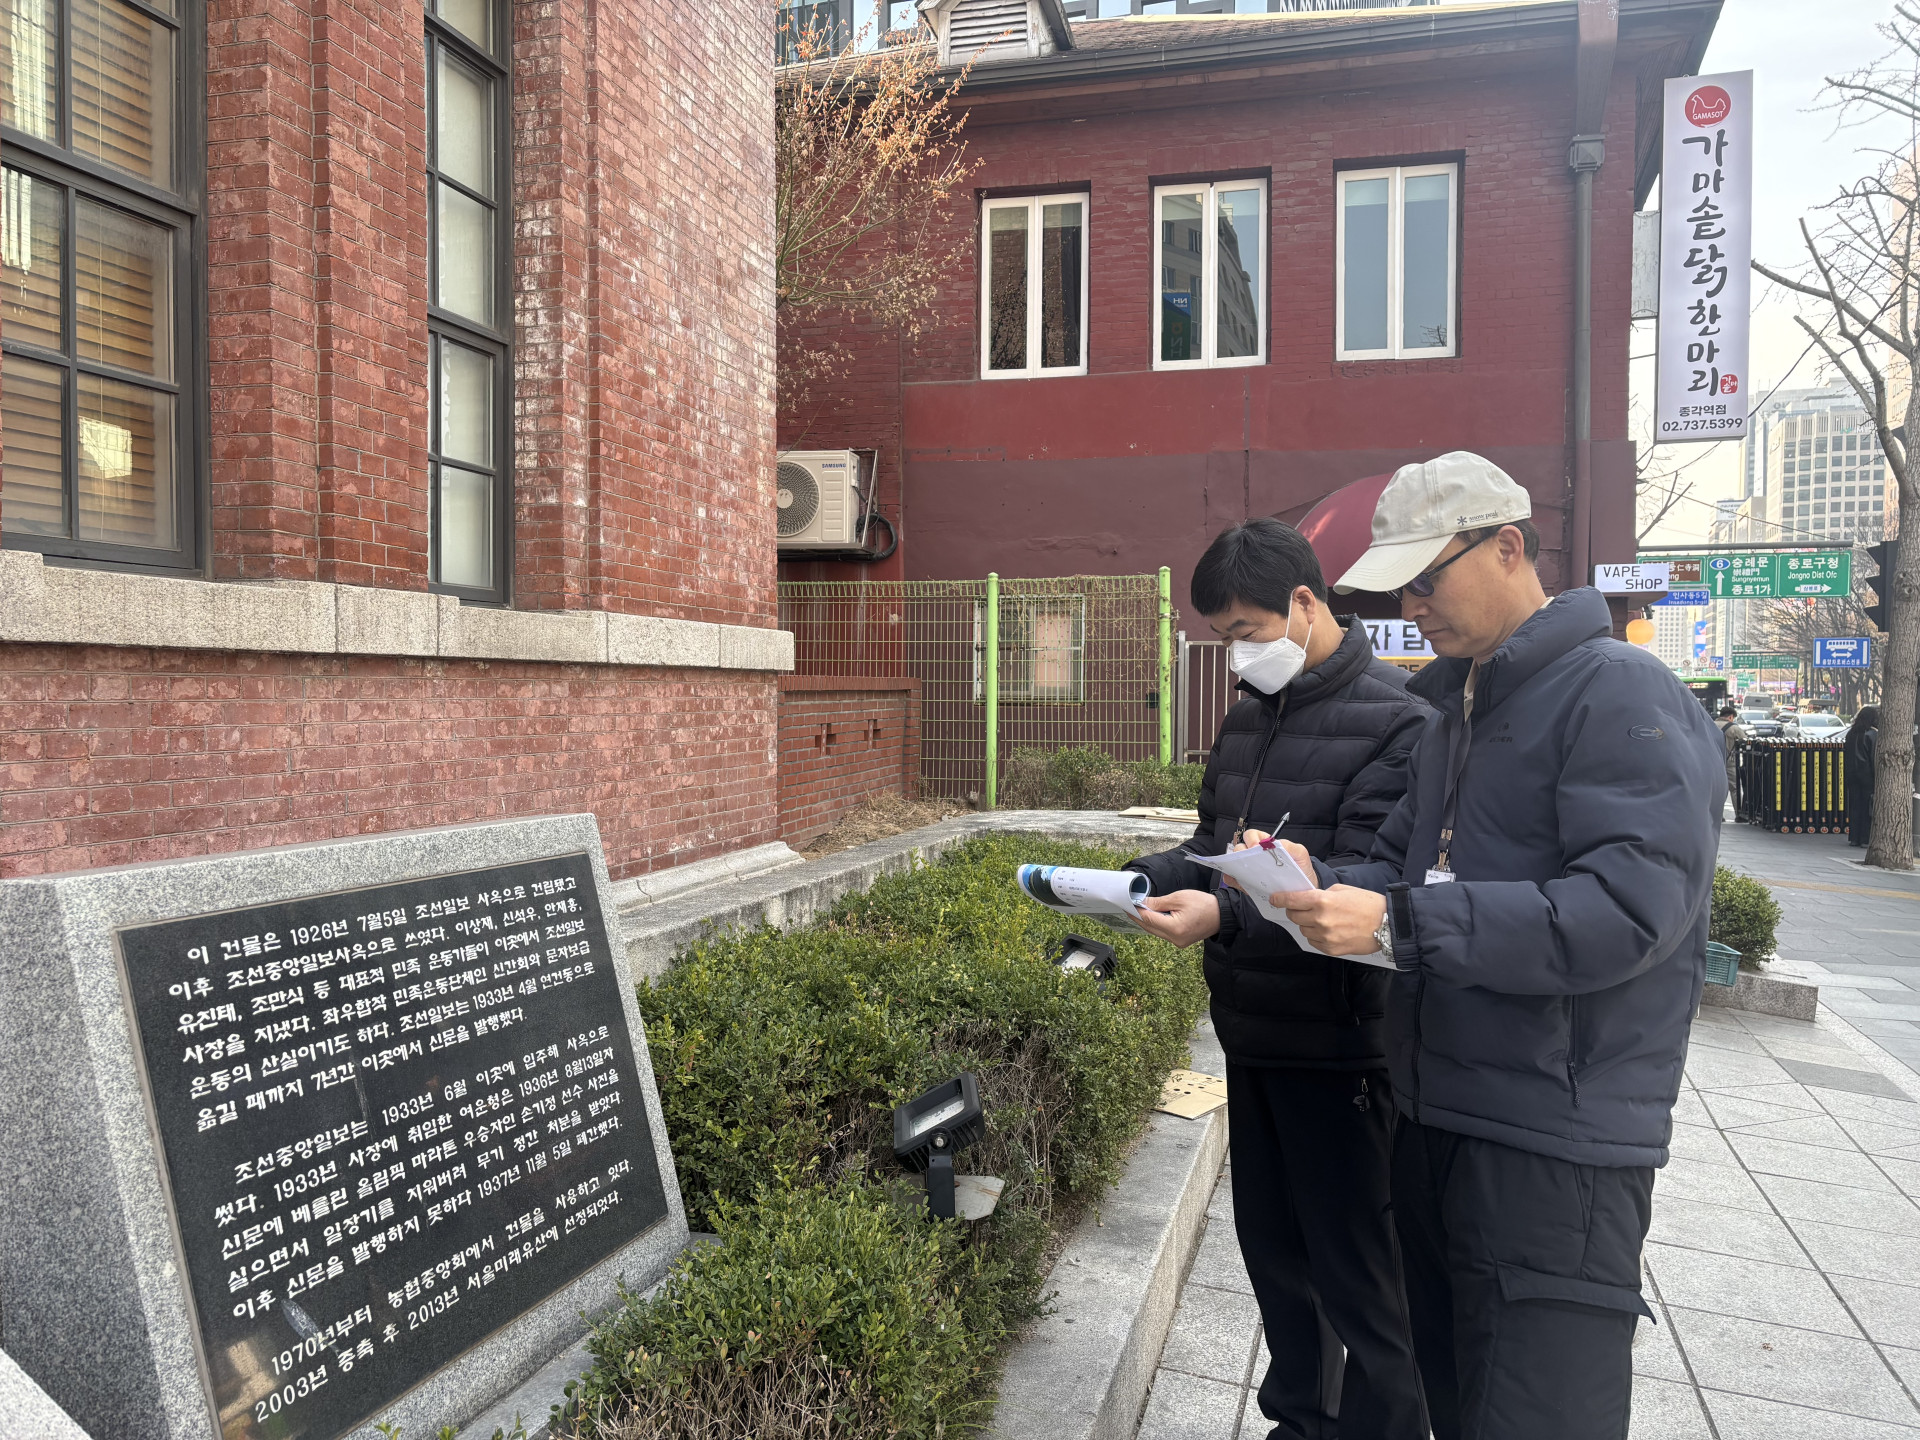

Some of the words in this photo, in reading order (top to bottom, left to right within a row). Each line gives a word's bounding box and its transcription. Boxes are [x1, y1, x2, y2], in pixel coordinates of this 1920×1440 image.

[1692, 110, 1724, 120] GAMASOT
[1662, 418, 1743, 432] 02.737.5399
[1679, 404, 1727, 417] 종각역점
[1603, 566, 1641, 578] VAPE
[1625, 578, 1663, 590] SHOP
[1672, 592, 1708, 600] 인사동5길
[1716, 560, 1724, 568] 6
[1731, 557, 1769, 568] 숭례문
[1731, 576, 1770, 584] Sungnyemun
[1731, 584, 1772, 595] 종로1가
[1787, 557, 1839, 569] 종로구청
[1787, 571, 1811, 581] Jongno
[1811, 571, 1825, 579] Dist
[1826, 570, 1838, 579] Ofc
[168, 977, 214, 1000] 이후
[405, 926, 450, 948] 쓰였다.
[455, 916, 498, 935] 이상재,
[502, 907, 541, 927] 신석우,
[544, 898, 582, 917] 안재홍,
[187, 946, 209, 964] 이
[220, 932, 281, 960] 건물은
[290, 919, 349, 945] 1926년
[357, 908, 407, 932] 7월5일
[415, 896, 470, 920] 조선일보
[477, 886, 526, 907] 사옥으로
[177, 1003, 243, 1035] 유진태,
[251, 986, 305, 1015] 조만식
[313, 980, 331, 1000] 등
[338, 967, 385, 991] 대표적
[392, 958, 421, 979] 민족
[428, 941, 490, 970] 운동가들이
[494, 929, 540, 952] 이곳에서
[545, 919, 586, 940] 조선일보
[183, 1033, 245, 1064] 사장을
[254, 1015, 316, 1043] 지냈다.
[322, 994, 387, 1025] 좌우합작
[392, 967, 488, 1007] 민족운동단체인
[492, 953, 541, 979] 신간회와
[546, 940, 590, 964] 문자보급
[189, 1063, 252, 1099] 운동의
[261, 1034, 351, 1077] 산실이기도
[357, 1022, 394, 1043] 하다.
[399, 1000, 470, 1033] 조선일보는
[472, 985, 515, 1011] 1933년
[518, 978, 538, 995] 4월
[540, 961, 595, 990] 연건동으로
[196, 1100, 238, 1132] 옮길
[245, 1078, 304, 1110] 때까지
[310, 1062, 356, 1090] 7년간
[361, 1039, 423, 1071] 이곳에서
[429, 1024, 470, 1052] 신문을
[474, 1006, 527, 1037] 발행했다.
[214, 1193, 264, 1228] 썼다.
[273, 1160, 338, 1201] 1933년
[348, 1135, 398, 1167] 사장에
[407, 1113, 453, 1144] 취임한
[459, 1088, 514, 1120] 여운형은
[519, 1069, 559, 1097] 1936년
[565, 1047, 614, 1078] 8월13일자
[234, 1120, 368, 1184] 조선중앙일보는
[382, 1092, 434, 1126] 1933년
[444, 1079, 468, 1101] 6월
[476, 1061, 515, 1086] 이곳에
[523, 1044, 559, 1070] 입주해
[566, 1025, 610, 1051] 사옥으로
[221, 1215, 284, 1260] 신문에
[291, 1187, 349, 1223] 베를린
[357, 1162, 406, 1199] 올림픽
[411, 1138, 458, 1169] 마라톤
[463, 1113, 515, 1148] 우승자인
[520, 1095, 556, 1124] 손기정
[561, 1084, 584, 1105] 선수
[587, 1068, 619, 1091] 사진을
[228, 1238, 309, 1293] 실으면서
[323, 1198, 395, 1246] 일장기를
[407, 1163, 467, 1203] 지워버려
[477, 1146, 504, 1169] 무기
[513, 1129, 539, 1153] 정간
[547, 1109, 582, 1134] 처분을
[588, 1090, 624, 1117] 받았다.
[233, 1290, 276, 1319] 이후
[286, 1256, 345, 1299] 신문을
[351, 1215, 420, 1265] 발행하지
[427, 1190, 472, 1226] 못하다
[477, 1165, 521, 1199] 1937년
[525, 1151, 547, 1174] 11월
[552, 1140, 572, 1161] 5일
[576, 1116, 623, 1146] 폐간했다.
[271, 1305, 373, 1375] 1970년부터
[388, 1235, 495, 1308] 농협중앙회에서
[505, 1207, 545, 1241] 건물을
[555, 1176, 600, 1210] 사용하고
[608, 1159, 633, 1183] 있다.
[255, 1364, 329, 1423] 2003년
[337, 1337, 374, 1372] 증축
[382, 1322, 400, 1344] 후
[407, 1286, 460, 1330] 2013년
[467, 1225, 559, 1290] 서울미래유산에
[564, 1190, 623, 1235] 선정되었다.
